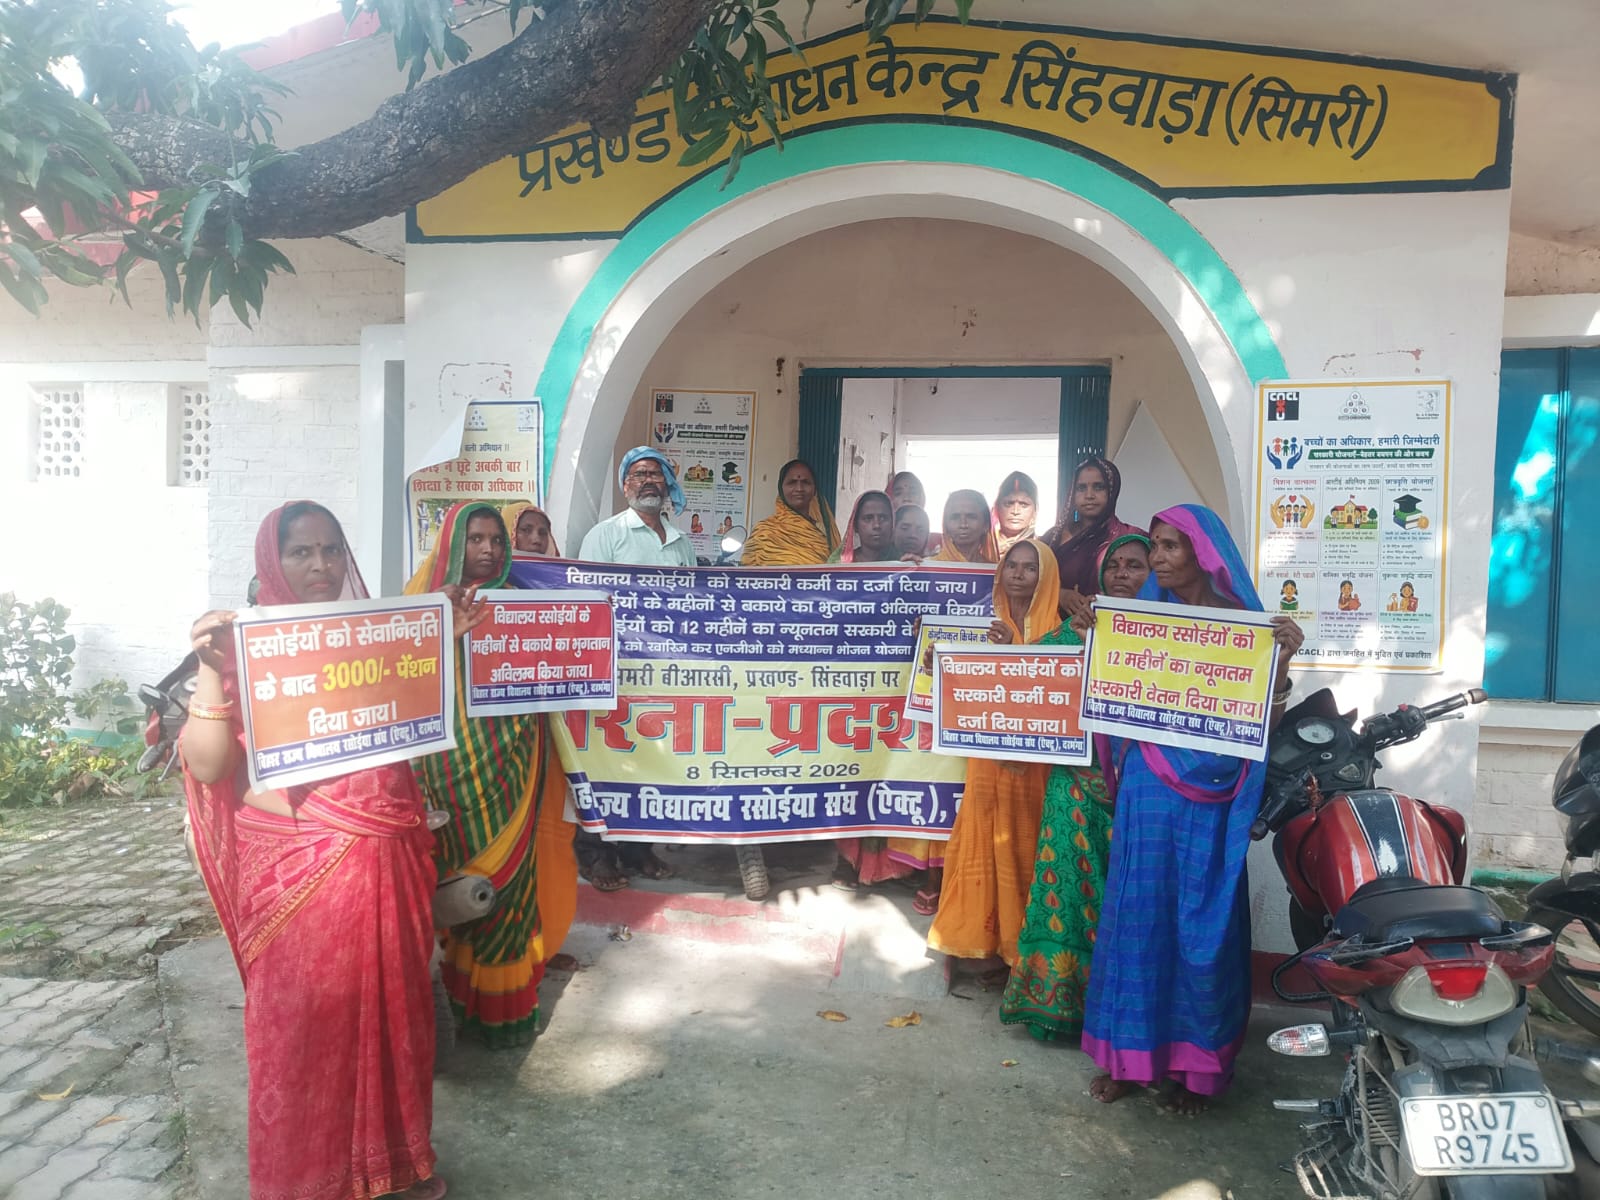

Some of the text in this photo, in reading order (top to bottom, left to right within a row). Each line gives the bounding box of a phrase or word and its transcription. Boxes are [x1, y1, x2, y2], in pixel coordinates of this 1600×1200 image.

[866, 36, 999, 114] केन्द्र
[1000, 39, 1229, 145] सिंहवाड़ा
[1225, 73, 1388, 161] (सिमरी)
[566, 567, 631, 587] विद्यालय
[707, 573, 729, 590] को
[735, 574, 791, 591] सरकारी
[797, 574, 832, 592] कर्मी
[836, 579, 858, 592] का
[863, 575, 893, 592] दर्जा
[899, 575, 930, 593] दिया
[494, 605, 536, 624] विद्यालय
[579, 605, 592, 623] के
[644, 592, 661, 610] के
[667, 593, 715, 613] महीनों
[721, 594, 736, 612] से
[741, 595, 786, 613] बकाये
[792, 600, 813, 613] का
[819, 600, 876, 618] भुगतान
[945, 598, 985, 616] किया
[247, 623, 323, 659] रसोईयों
[325, 621, 352, 650] को
[652, 615, 675, 634] को
[681, 621, 699, 634] 12
[752, 622, 775, 636] का
[780, 623, 839, 641] न्यूनतम
[844, 619, 897, 637] सरकारी
[1112, 613, 1256, 650] विद्यालय रसोईयों को
[472, 633, 508, 656] महीनों
[509, 633, 520, 653] से
[522, 633, 553, 652] बकाये
[555, 637, 570, 651] का
[573, 637, 612, 658] भुगतान
[625, 639, 643, 652] को
[691, 643, 712, 655] कर
[766, 640, 784, 655] को
[836, 641, 871, 656] भोजन
[874, 641, 912, 656] योजना
[254, 653, 438, 701] के बाद 3000/- पेंशन
[537, 661, 564, 680] किया
[661, 663, 738, 691] बीआरसी,
[811, 665, 876, 692] सिंहवाड़ा
[881, 671, 901, 688] पर
[941, 656, 1083, 679] विद्यालय रसोईयों को
[1107, 651, 1120, 666] 12
[1169, 658, 1191, 675] का
[1194, 662, 1254, 687] न्यूनतम
[953, 684, 1006, 704] सरकारी
[1010, 686, 1044, 705] कर्मी
[1048, 691, 1070, 705] का
[1090, 678, 1143, 700] सरकारी
[1147, 682, 1181, 707] वेतन
[1185, 687, 1219, 713] दिया
[307, 706, 349, 737] दिया
[957, 711, 987, 730] दर्जा
[991, 711, 1024, 732] दिया
[686, 760, 860, 780] 8 सितम्बर 2026
[638, 786, 733, 822] विद्यालय
[739, 786, 818, 824] रसोईया
[823, 784, 859, 818] संघ
[1437, 1100, 1518, 1132] BR07
[1434, 1132, 1540, 1165] R9745
